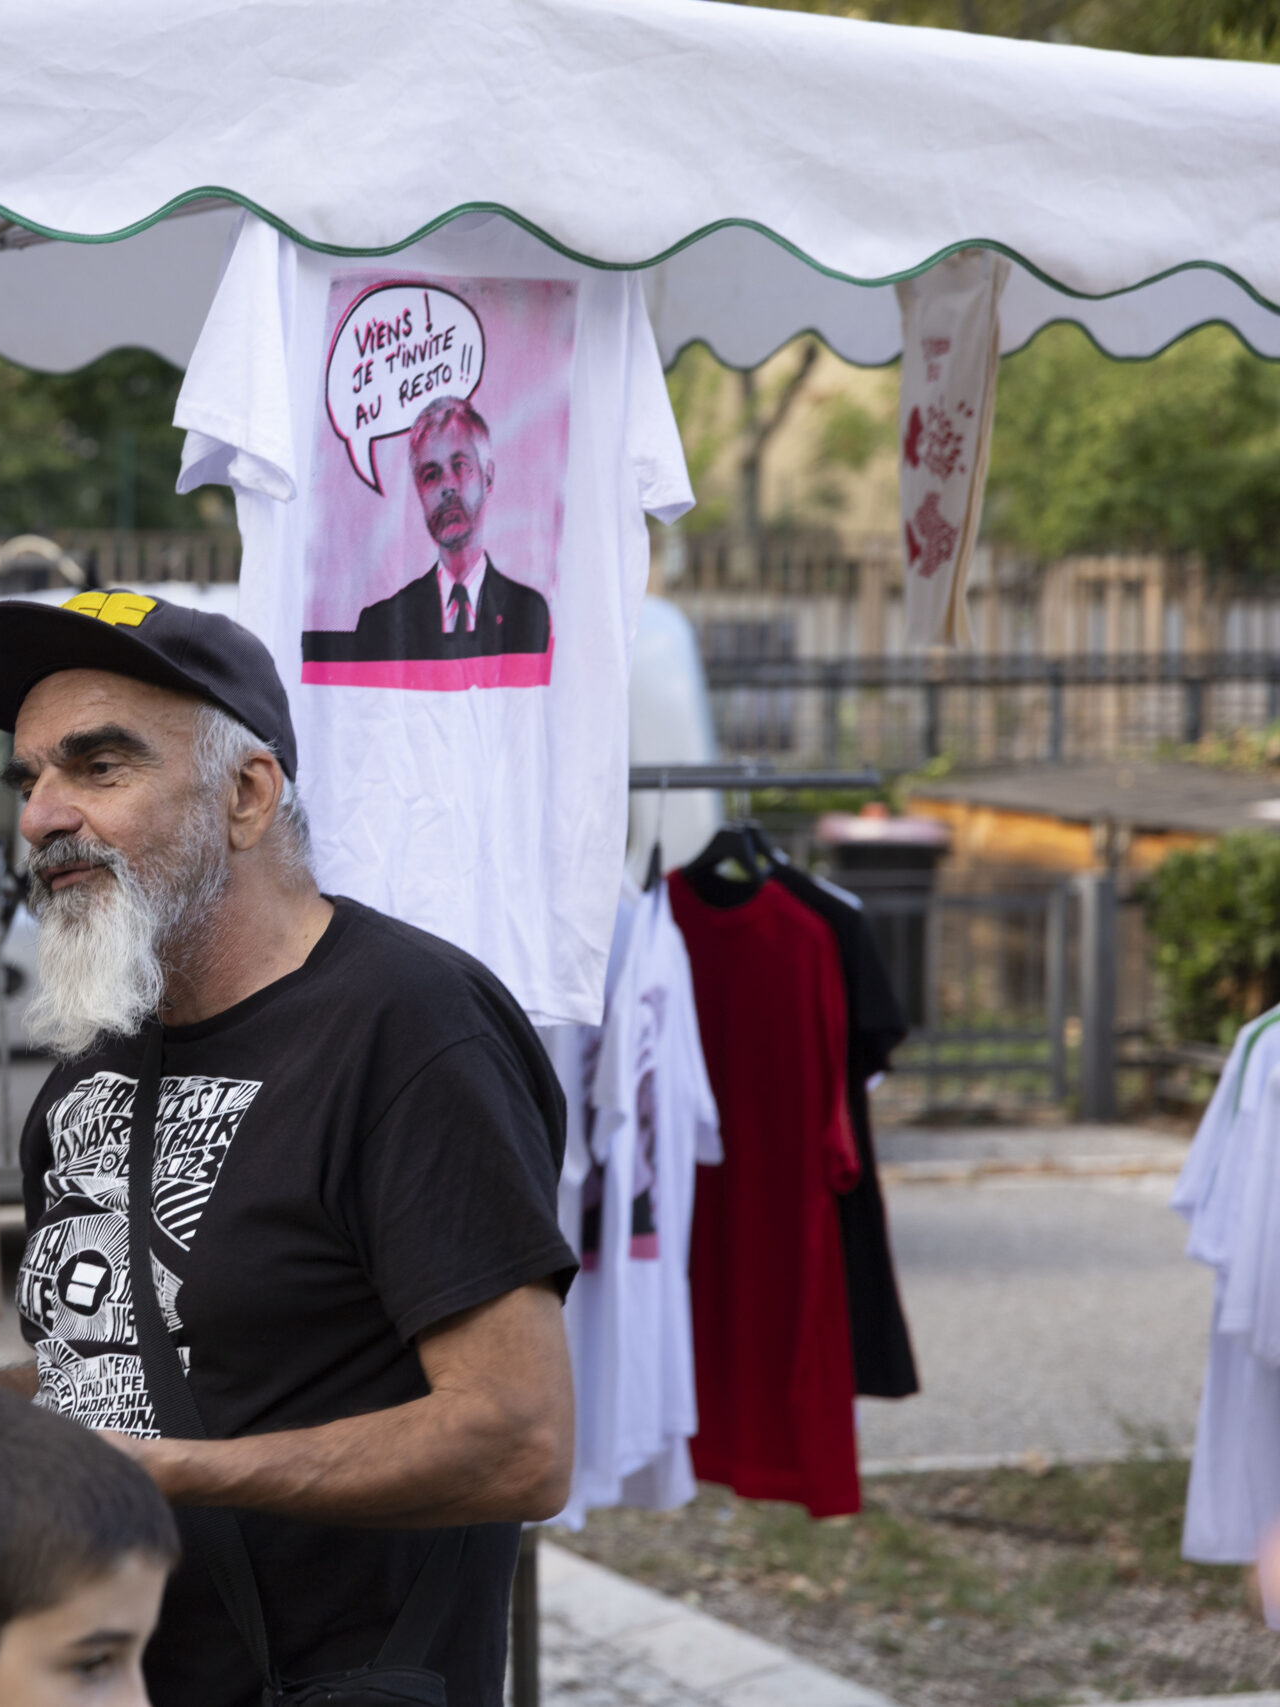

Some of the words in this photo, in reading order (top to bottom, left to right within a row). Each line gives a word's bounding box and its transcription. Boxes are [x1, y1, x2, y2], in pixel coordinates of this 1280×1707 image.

[354, 308, 412, 358] VIENS
[352, 358, 374, 394] JE
[356, 394, 382, 430] AU
[399, 362, 452, 408] RESTO
[77, 1391, 152, 1413] WORKSHO
[80, 1380, 103, 1399] AND
